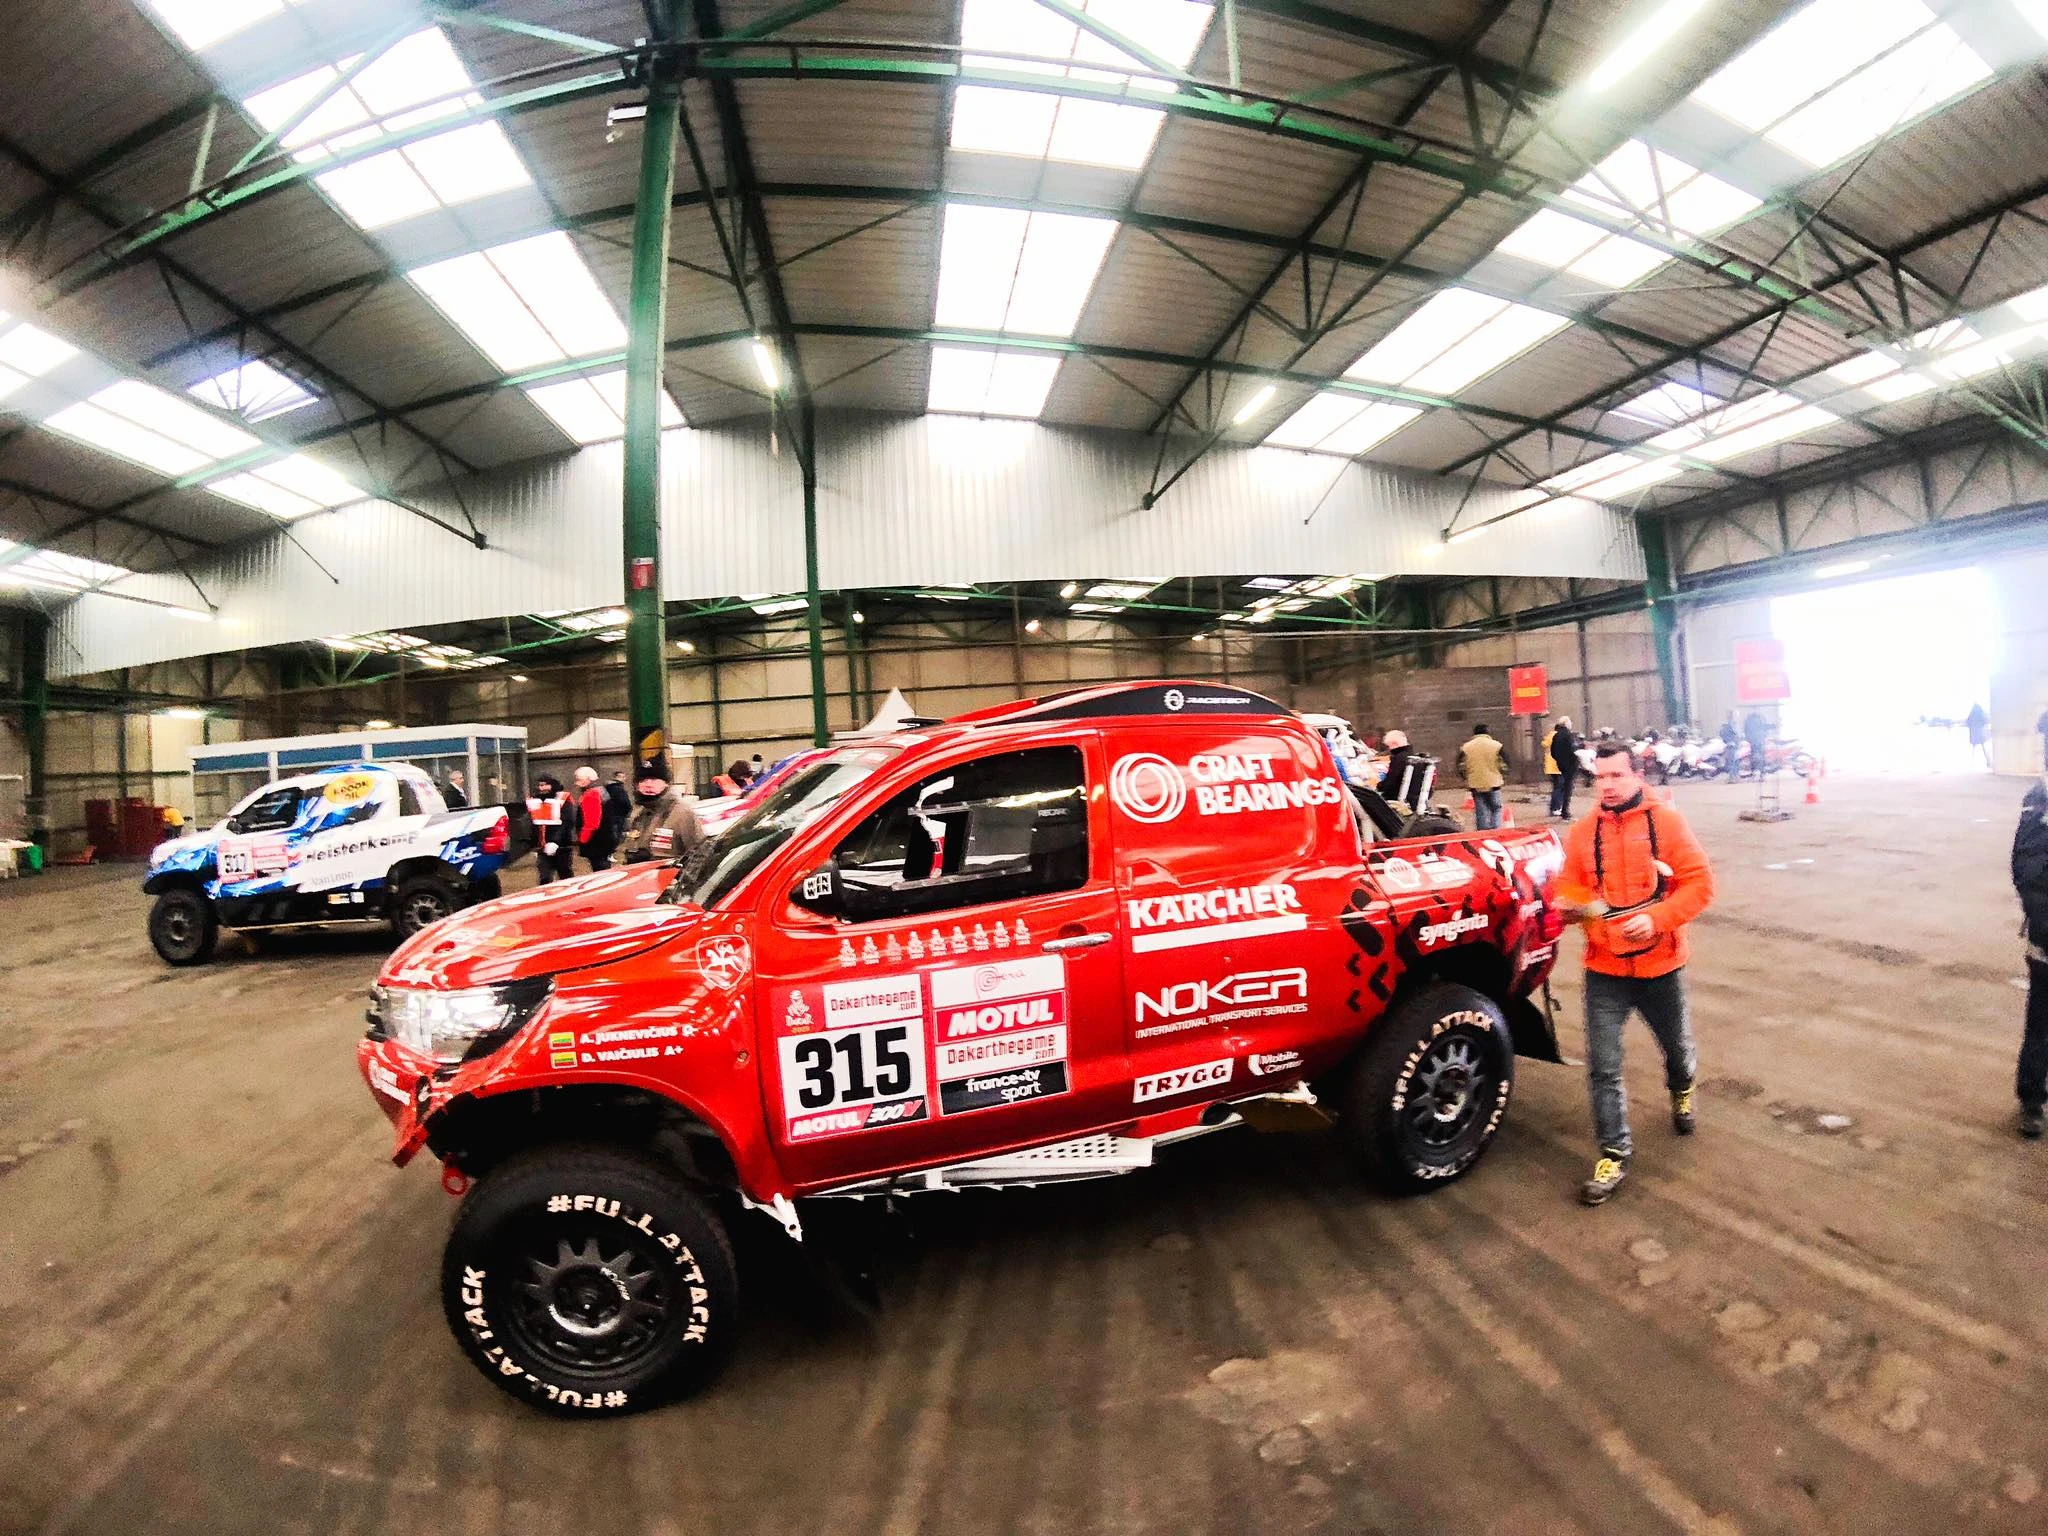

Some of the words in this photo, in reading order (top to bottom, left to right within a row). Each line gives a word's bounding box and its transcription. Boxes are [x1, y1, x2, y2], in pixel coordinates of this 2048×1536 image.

[1189, 753, 1275, 782] CRAFT
[1195, 776, 1342, 816] BEARINGS
[1128, 884, 1302, 928] KÄRCHER
[1418, 912, 1489, 946] syngenta
[831, 990, 917, 1011] Dakarthegame
[1135, 967, 1307, 1022] NOKER
[947, 999, 1054, 1037] MOTUL
[1136, 1015, 1208, 1039] INTERNATIONAL
[1208, 1008, 1262, 1025] TRANSPORT
[1262, 1003, 1308, 1017] SERVICES
[581, 1052, 596, 1063] D.
[664, 1045, 684, 1057] A+
[947, 1034, 1056, 1064] Dakarthegame
[1259, 1051, 1300, 1065] Mobile
[795, 1026, 911, 1109] 315
[1139, 1064, 1228, 1097] TRYGG
[1001, 1081, 1043, 1104] sport
[792, 1111, 862, 1137] MOTUL
[867, 1099, 924, 1123] 300V
[658, 1232, 710, 1344] ATTACK
